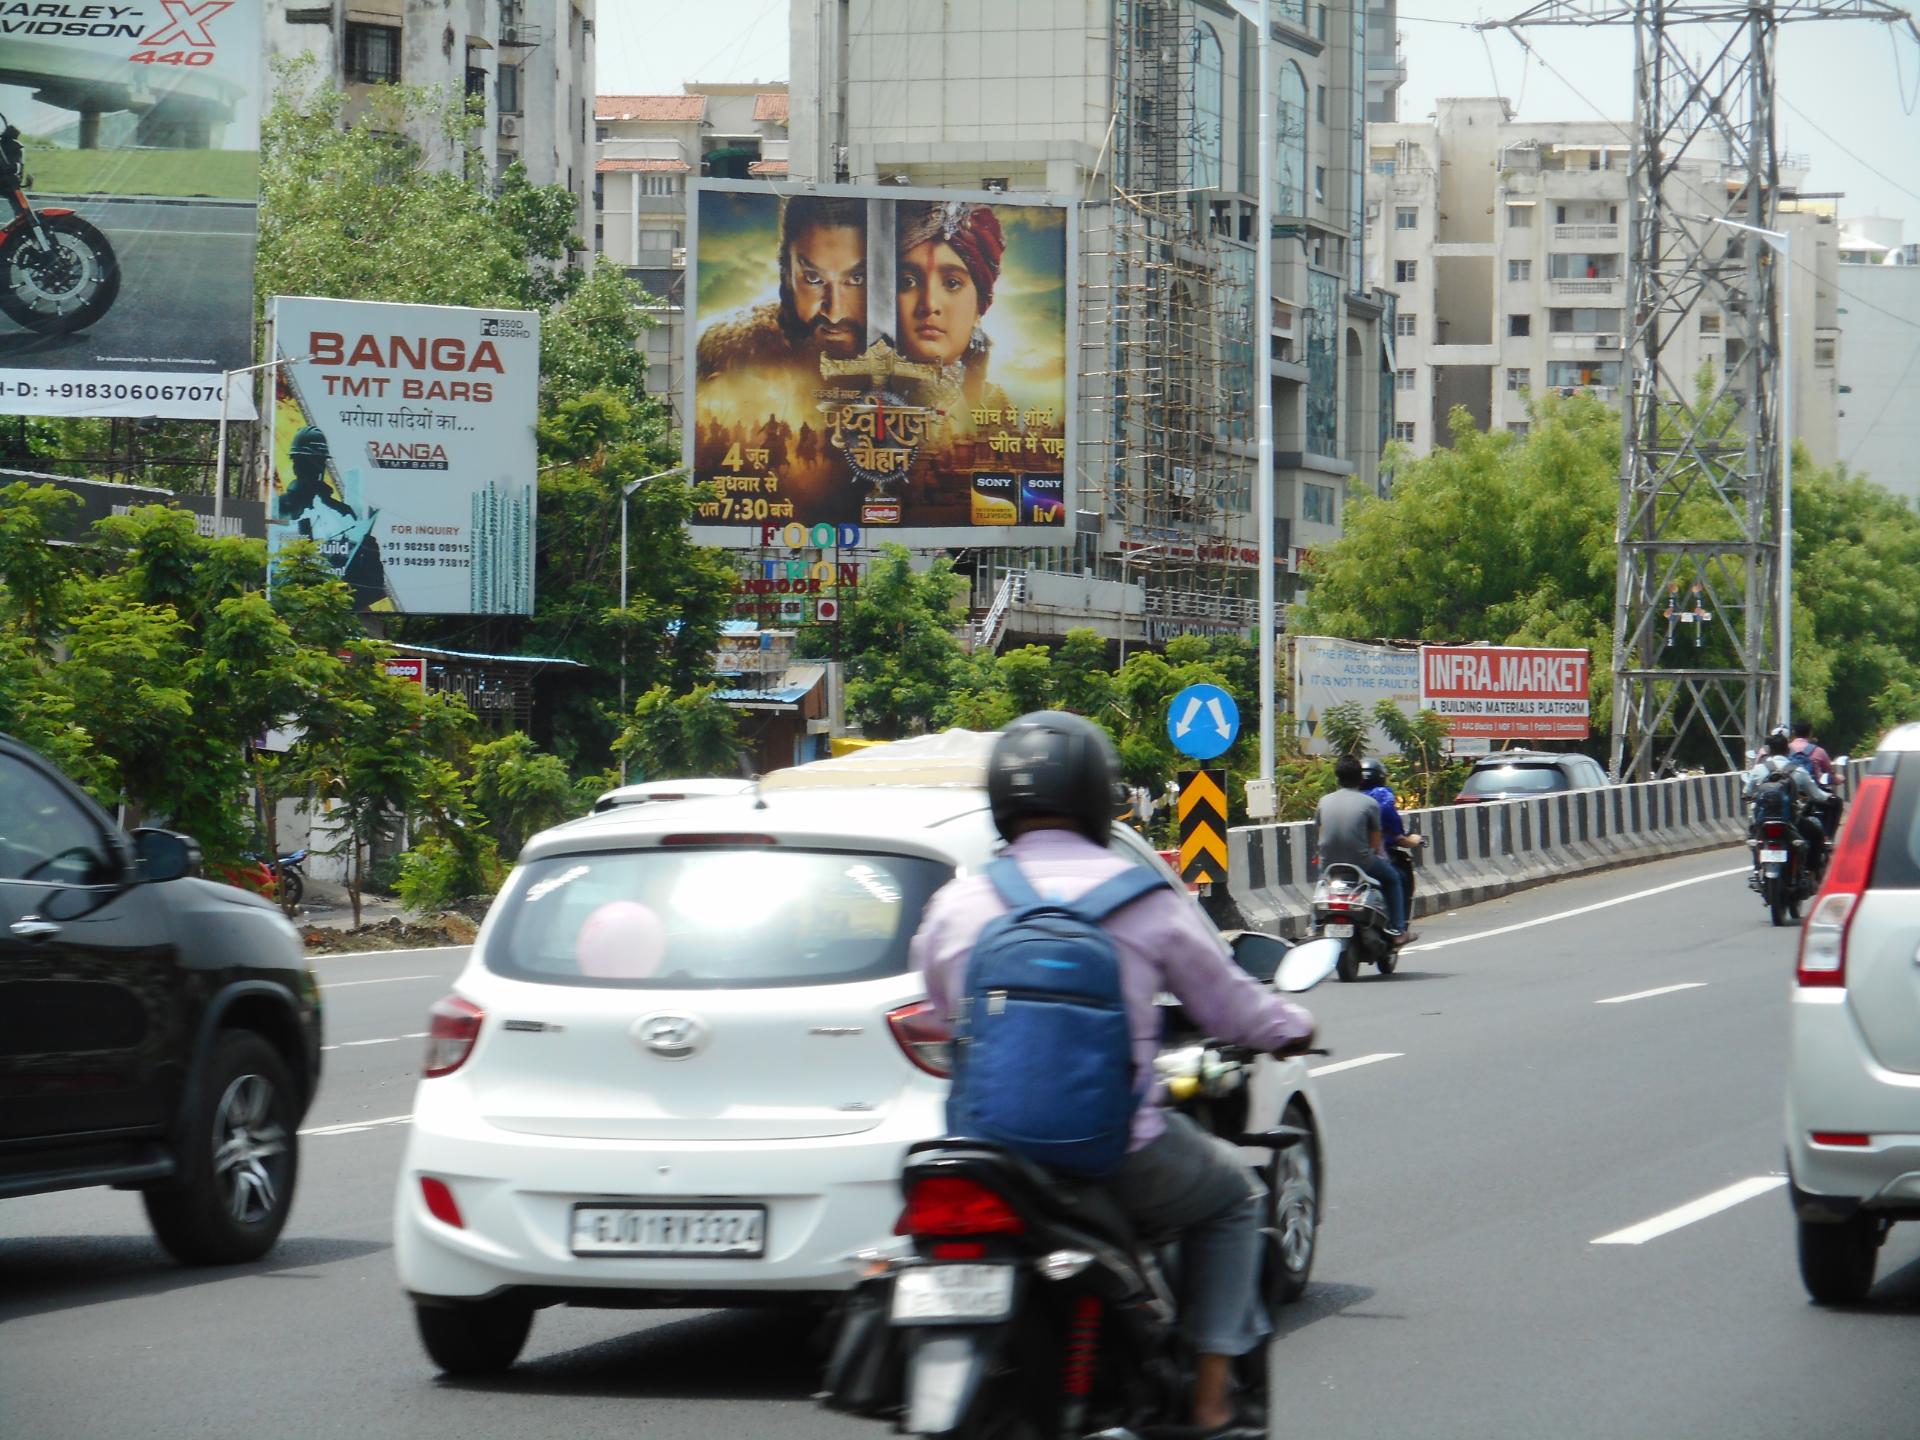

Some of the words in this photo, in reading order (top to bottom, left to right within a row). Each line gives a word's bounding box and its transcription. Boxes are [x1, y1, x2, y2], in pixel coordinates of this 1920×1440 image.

[0, 20, 146, 38] VIDSON
[138, 0, 235, 47] X
[128, 50, 215, 66] 440
[309, 331, 505, 374] BANGA
[322, 375, 391, 398] TMT
[402, 379, 493, 403] BARS
[339, 405, 383, 427] भरोसा
[387, 406, 433, 431] सदियों
[823, 395, 929, 448] पृथ्वीराज
[971, 404, 1002, 425] सोच
[1006, 406, 1018, 426] में
[368, 441, 447, 460] BANGA
[988, 431, 1021, 453] जीत
[1024, 431, 1038, 453] में
[721, 442, 744, 472] 4
[745, 448, 769, 470] जून
[849, 435, 913, 473] चौहान
[383, 460, 408, 468] TMT
[411, 461, 444, 469] BARS
[713, 475, 760, 498] बुधवार
[763, 471, 778, 492] से
[976, 478, 1012, 487] SONY
[1028, 480, 1062, 488] SONY
[698, 502, 719, 517] रात
[720, 498, 768, 520] 7:30
[769, 499, 794, 518] बजे
[391, 525, 412, 534] FOR
[415, 525, 460, 536] INQUIRY
[760, 522, 860, 549] FOOD
[316, 541, 348, 554] Build
[382, 542, 400, 551] +91
[404, 542, 436, 552] 98258
[439, 543, 470, 553] 08915
[382, 557, 400, 566] +91
[404, 558, 436, 567] 94299
[761, 560, 860, 590] IKON
[1338, 649, 1360, 661] FIRE
[1364, 652, 1385, 661] THAT
[1343, 664, 1370, 674] ALSO
[1429, 654, 1586, 693] INFRA.MARKET
[1310, 675, 1320, 685] IT
[1322, 675, 1331, 686] IS
[1334, 677, 1353, 688] NOT
[1357, 678, 1375, 688] THE
[1378, 678, 1408, 689] FAULT
[1431, 701, 1437, 711] A
[1440, 701, 1482, 713] BUILDING
[1485, 702, 1534, 714] MATERIALS
[1538, 702, 1585, 714] PLATFORM
